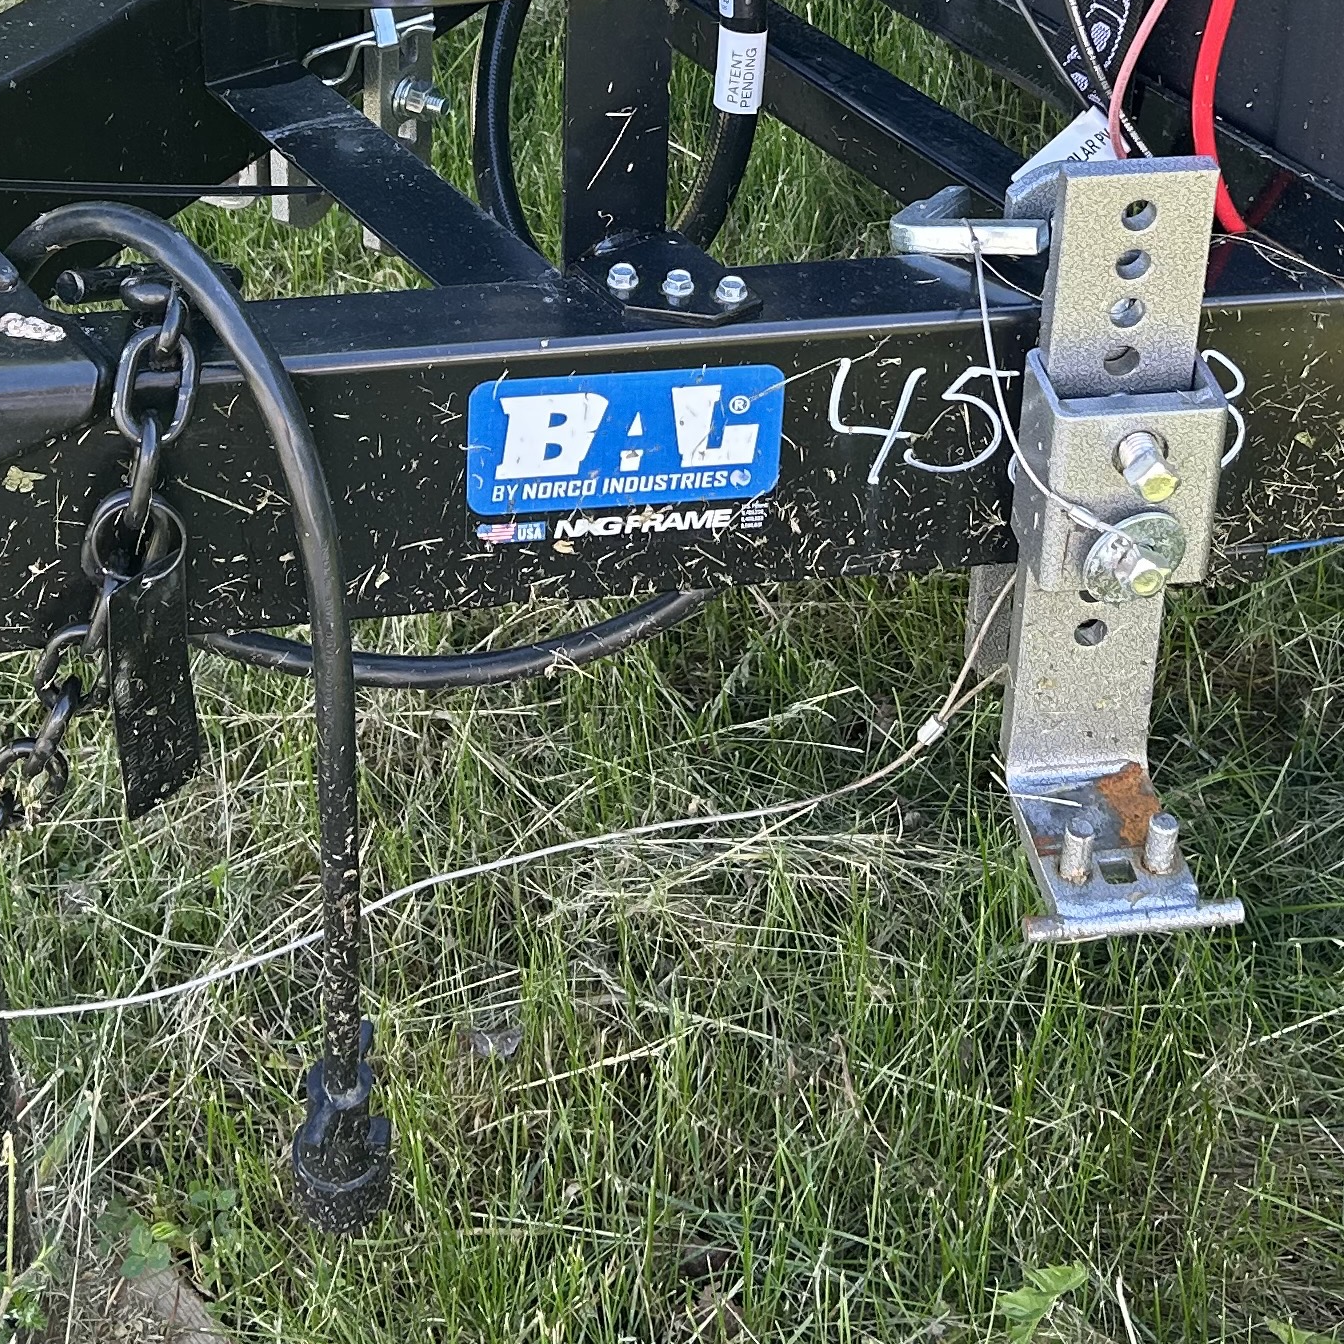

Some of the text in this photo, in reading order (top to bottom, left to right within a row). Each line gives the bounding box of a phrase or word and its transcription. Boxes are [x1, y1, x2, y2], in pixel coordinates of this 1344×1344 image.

[726, 47, 744, 104] PATENT
[740, 47, 758, 109] PENDING
[1066, 139, 1102, 163] LAR
[492, 469, 730, 503] BY NORCO INDUSTRIES
[517, 526, 543, 542] USA
